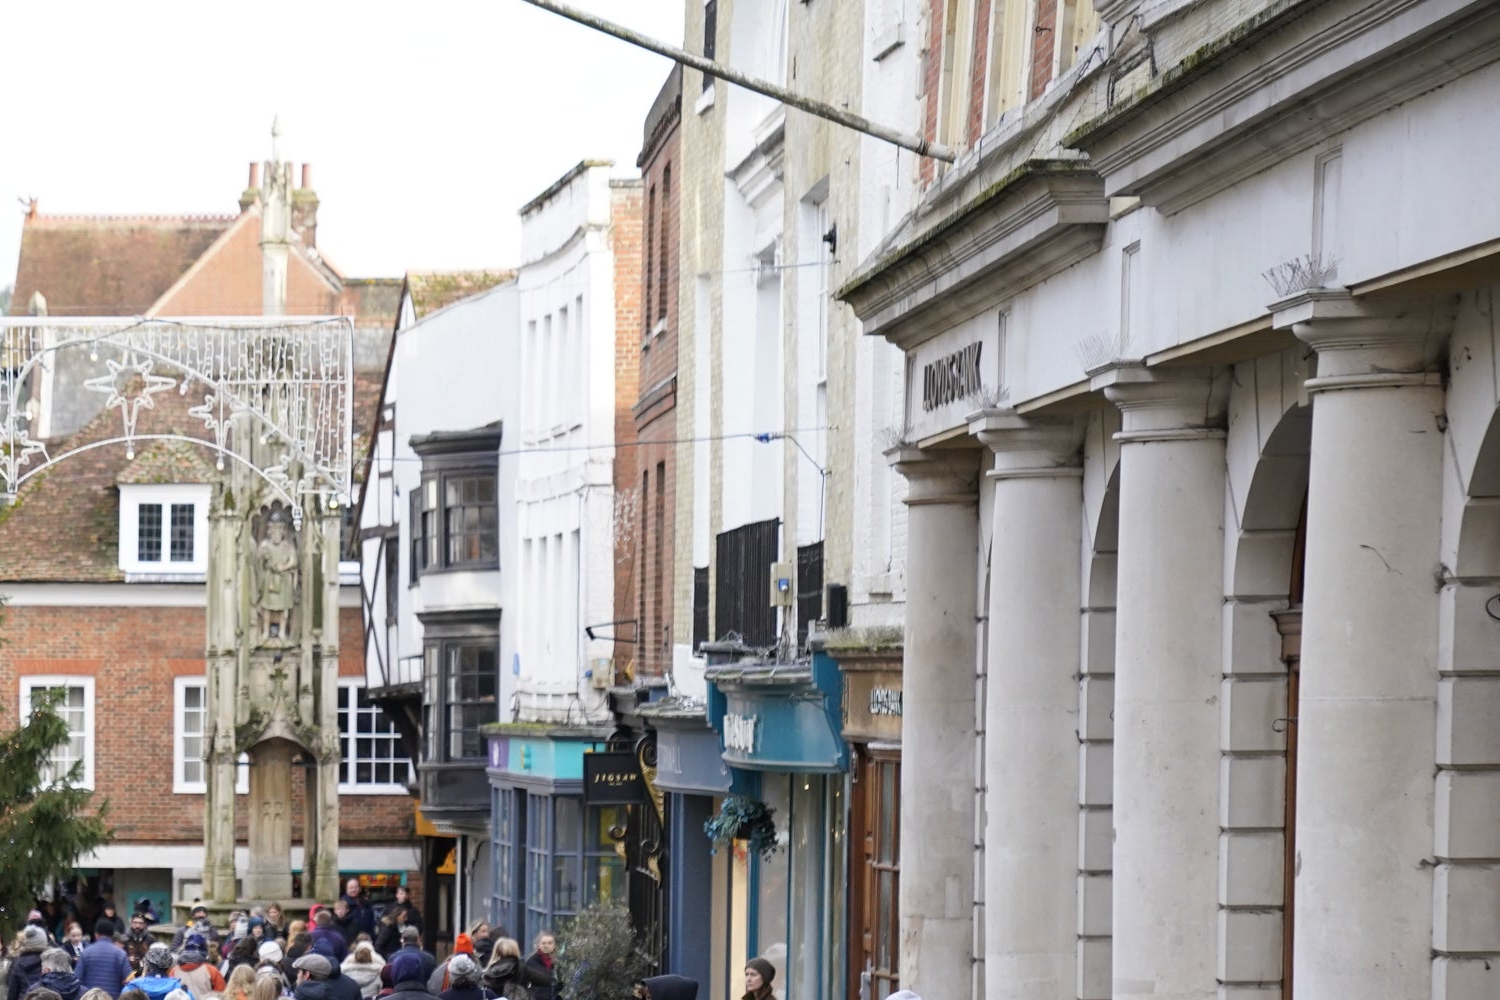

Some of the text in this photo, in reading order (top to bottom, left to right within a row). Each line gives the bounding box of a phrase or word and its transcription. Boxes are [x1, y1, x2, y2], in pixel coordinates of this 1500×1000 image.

[923, 341, 982, 413] LLOYDS BANK
[594, 773, 638, 784] JIGSAW
